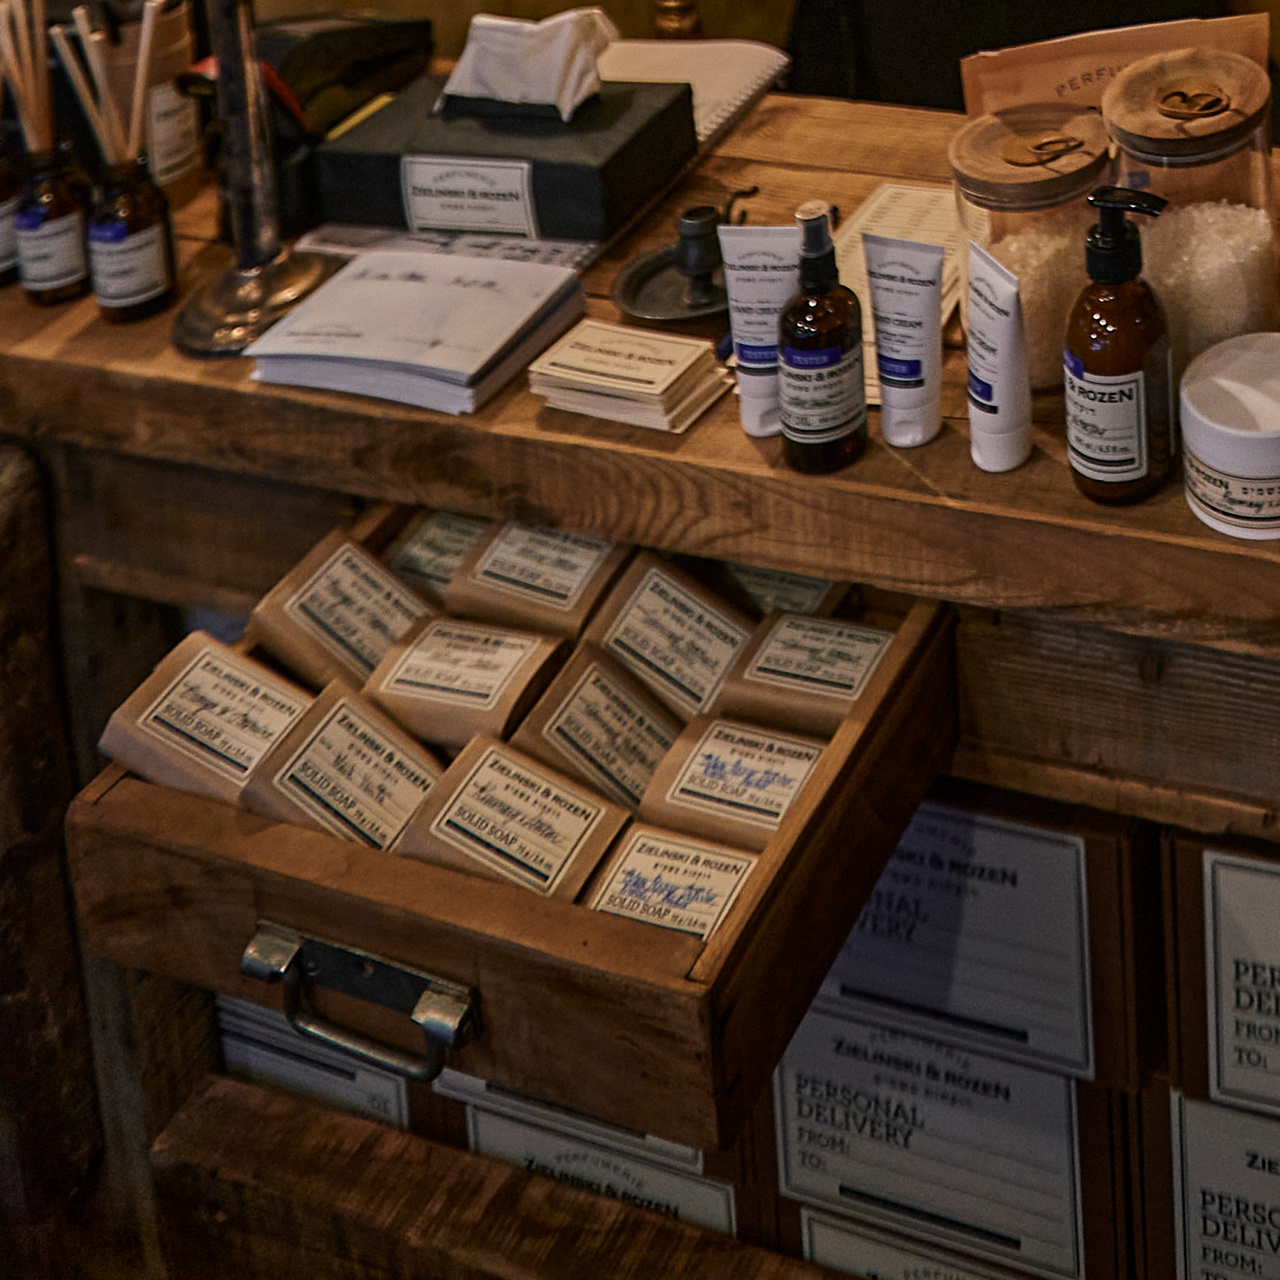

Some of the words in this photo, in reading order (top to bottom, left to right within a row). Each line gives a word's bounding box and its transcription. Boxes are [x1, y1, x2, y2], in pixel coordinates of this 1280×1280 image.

[1078, 386, 1133, 404] ROZEN
[164, 702, 195, 727] SOLID
[195, 720, 223, 741] SOAP
[338, 714, 385, 757] ZIELINSKI
[384, 752, 394, 763] &
[395, 760, 431, 792] ROZEN
[714, 730, 765, 750] ZIELINSKI
[766, 743, 775, 753] &
[775, 747, 814, 763] ROZEN
[299, 759, 330, 791] SOLID
[328, 784, 357, 810] SOAP
[489, 759, 541, 793] ZIELINSKI
[541, 787, 552, 798] &
[552, 794, 592, 821] ROZEN
[455, 806, 488, 831] SOLID
[489, 824, 518, 846] SOAP
[636, 842, 690, 863] ZIELINSKI
[690, 855, 701, 866] &
[702, 858, 743, 876] ROZEN
[949, 859, 1018, 887] ROZEN
[607, 894, 640, 913] SOLID
[641, 903, 671, 920] SOAP
[834, 1037, 922, 1077] ZIELINSKI
[925, 1062, 941, 1082] &
[944, 1071, 1011, 1103] ROZEN
[1234, 1044, 1269, 1070] TO:
[795, 1074, 925, 1129] PERSONAL
[796, 1097, 913, 1150] DELIVERY
[797, 1126, 849, 1154] FROM:
[1202, 1245, 1264, 1276] FROM:
